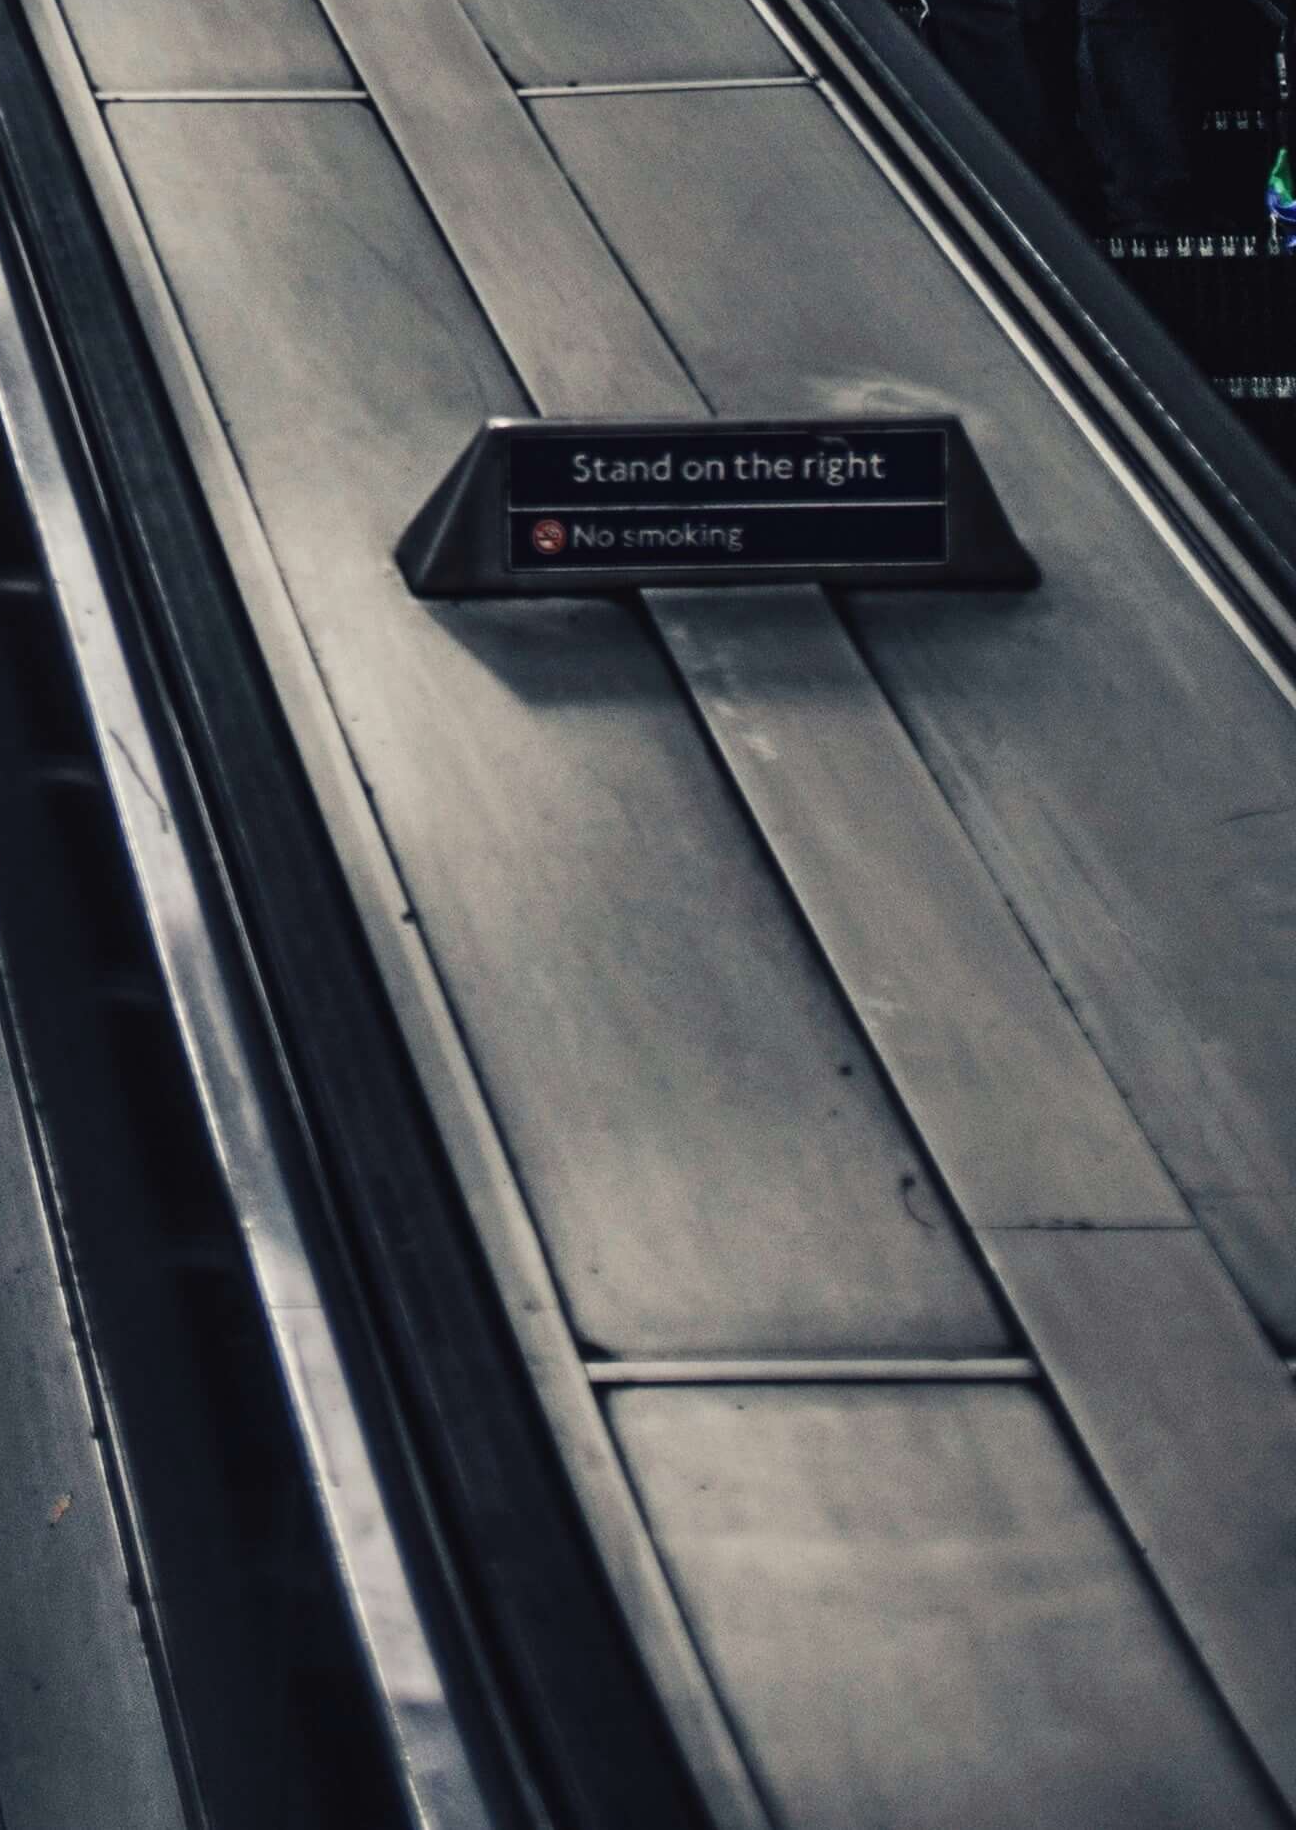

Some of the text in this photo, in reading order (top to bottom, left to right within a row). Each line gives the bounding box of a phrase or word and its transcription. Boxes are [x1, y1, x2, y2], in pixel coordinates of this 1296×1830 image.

[573, 452, 886, 488] Stand on the right
[573, 523, 744, 553] No smoking
